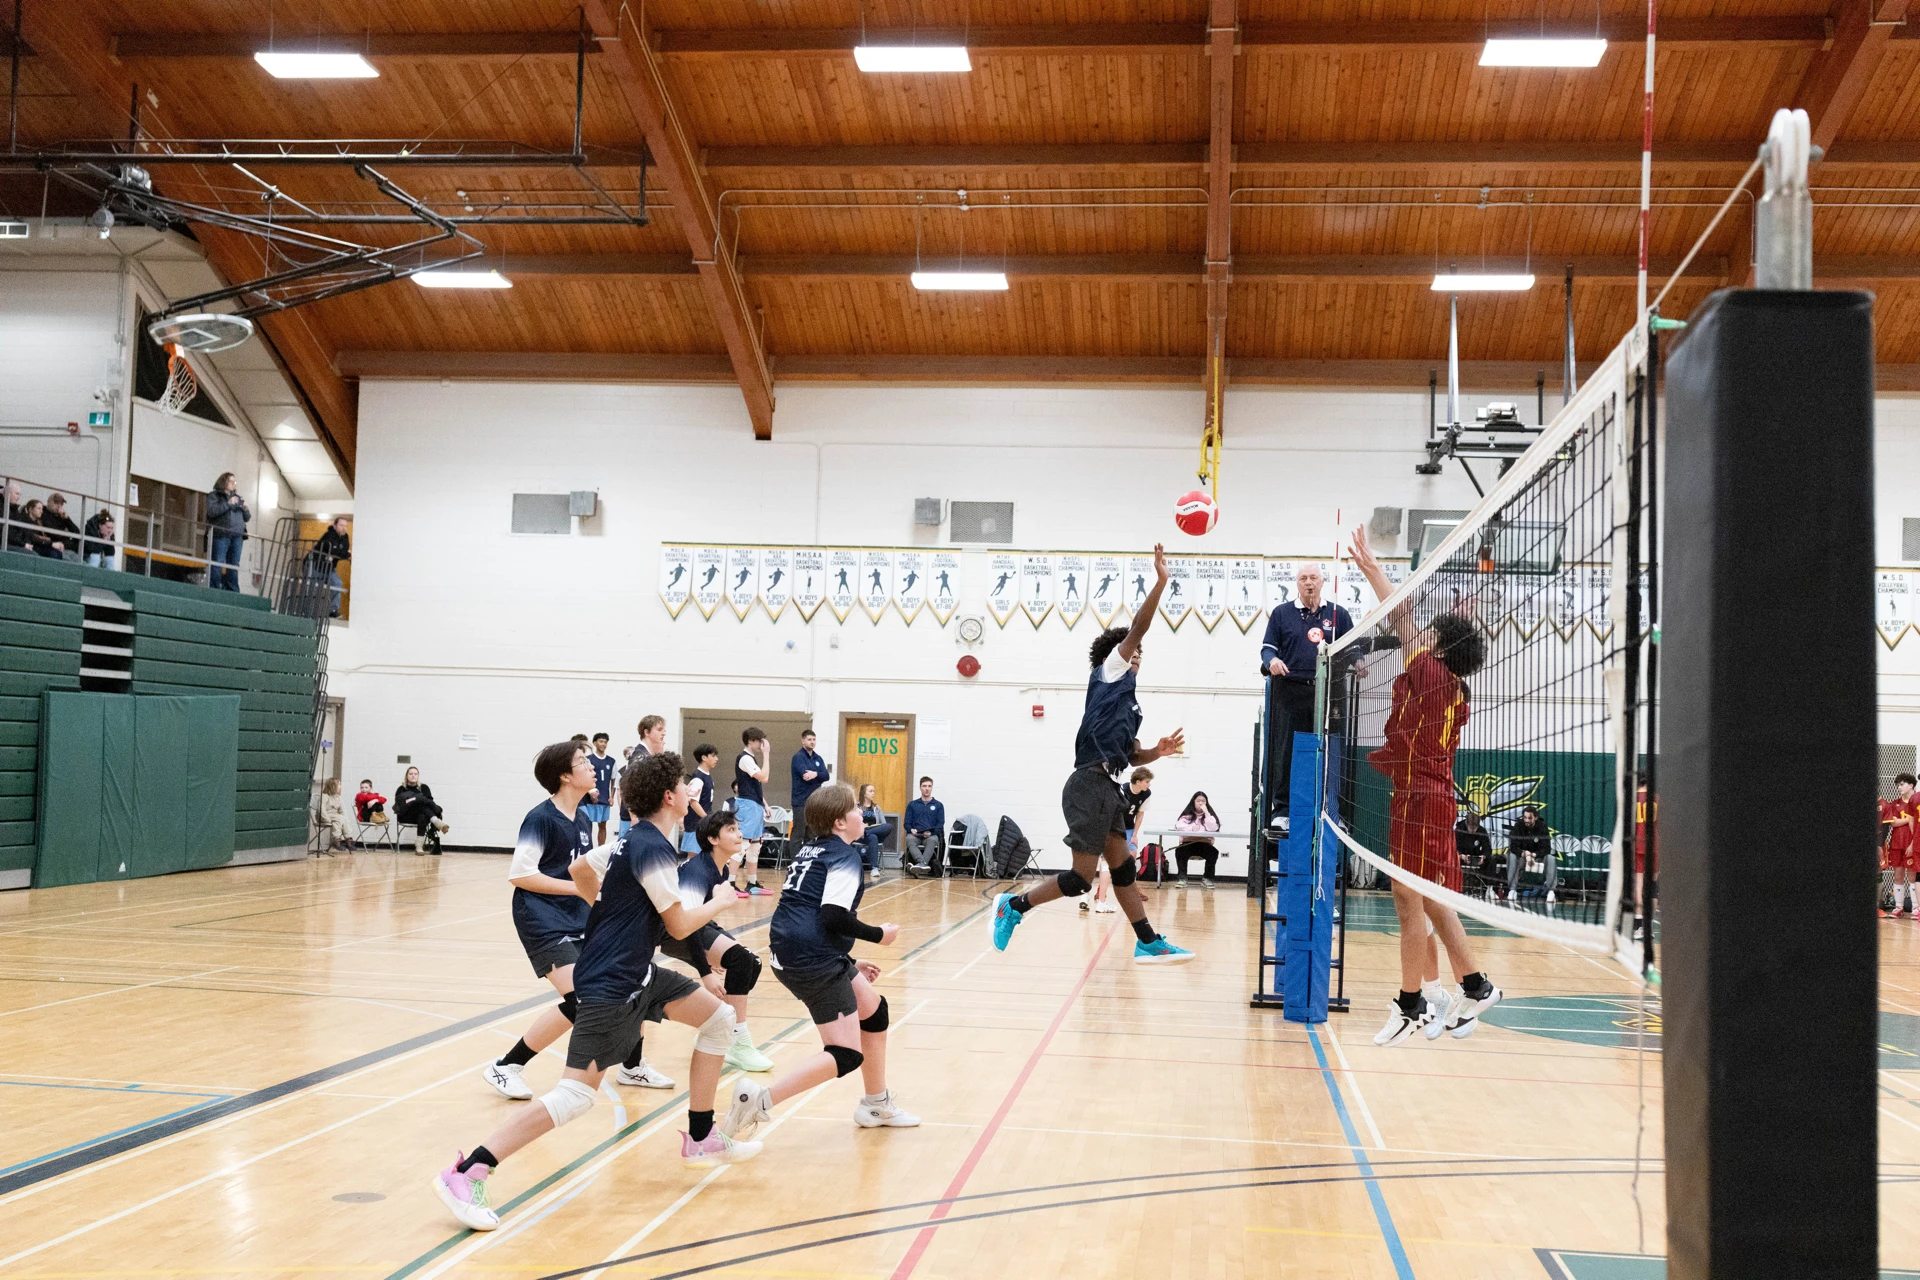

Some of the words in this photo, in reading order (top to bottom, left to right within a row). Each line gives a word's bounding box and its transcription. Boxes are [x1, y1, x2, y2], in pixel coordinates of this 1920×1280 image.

[858, 737, 899, 755] BOYS
[600, 769, 605, 781] 1
[1128, 804, 1136, 815] 2
